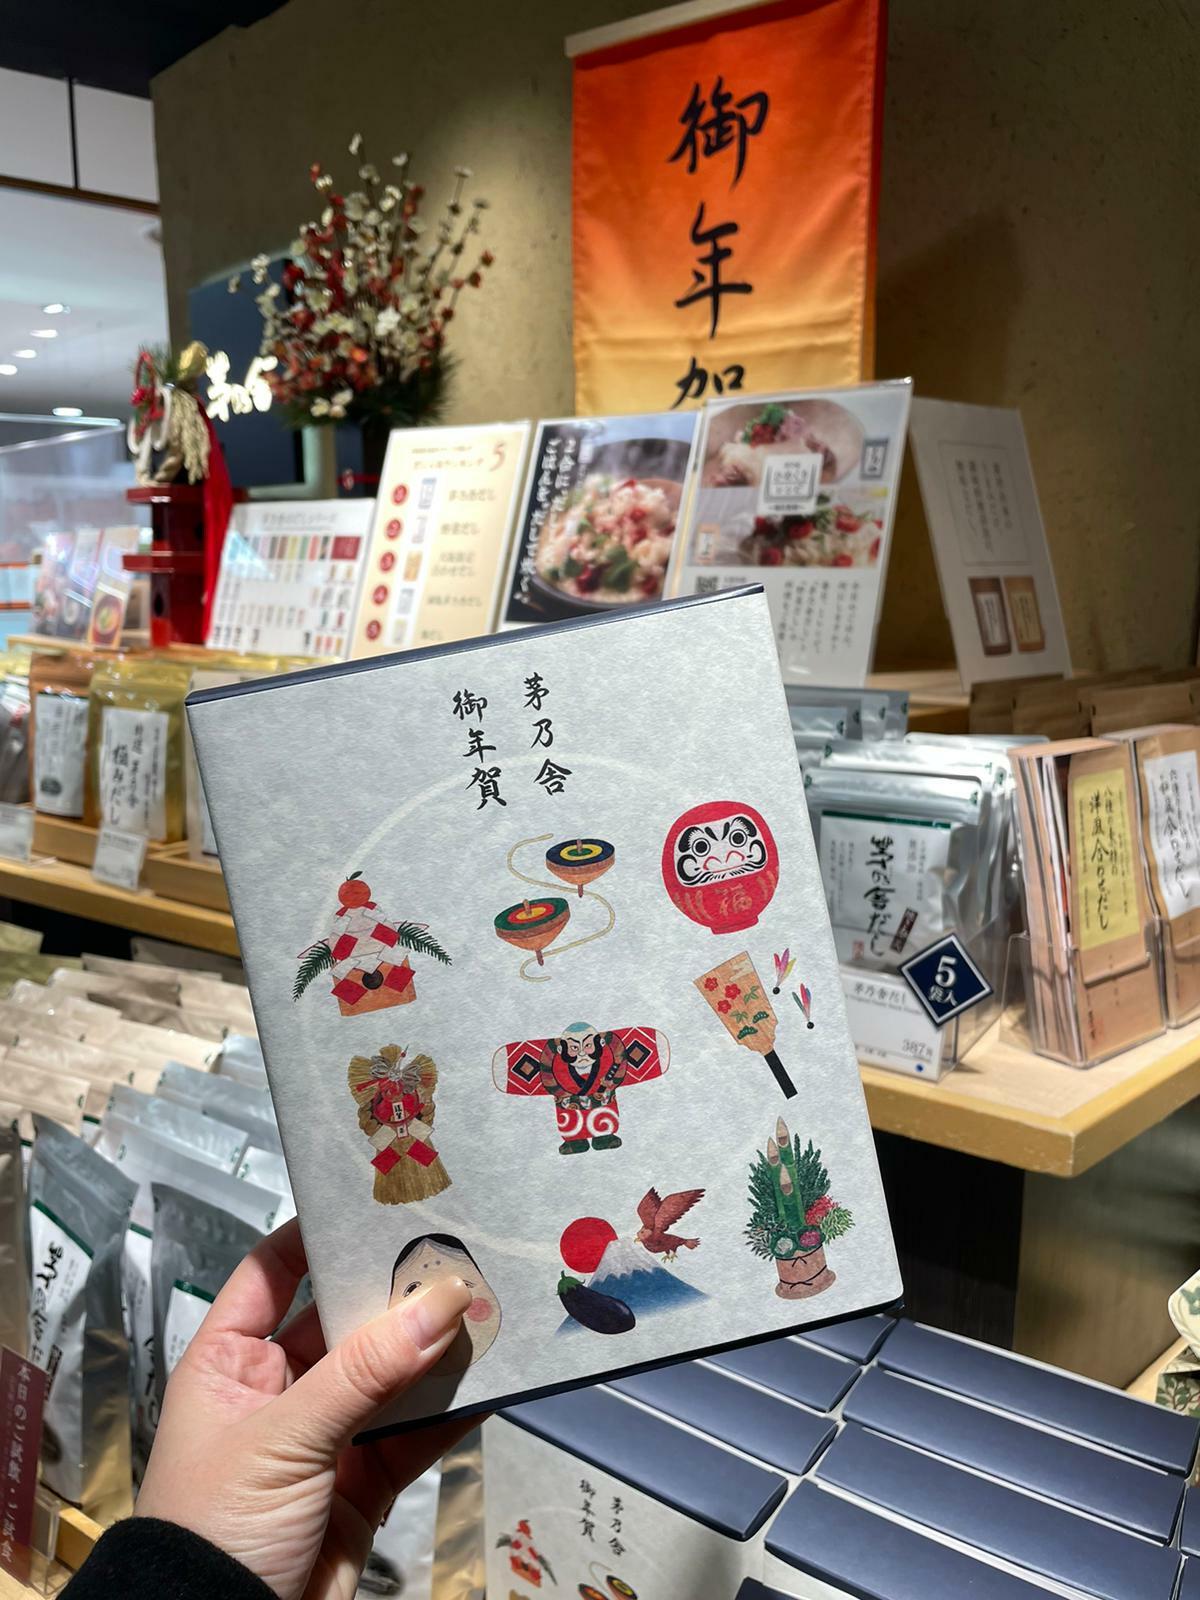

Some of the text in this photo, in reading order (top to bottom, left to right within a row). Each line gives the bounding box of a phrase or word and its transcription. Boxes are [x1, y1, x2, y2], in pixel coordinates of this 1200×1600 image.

[452, 688, 507, 811] 御年賀
[523, 671, 573, 796] 茅乃舎
[934, 954, 958, 989] 5
[608, 1495, 627, 1557] 茅乃舎
